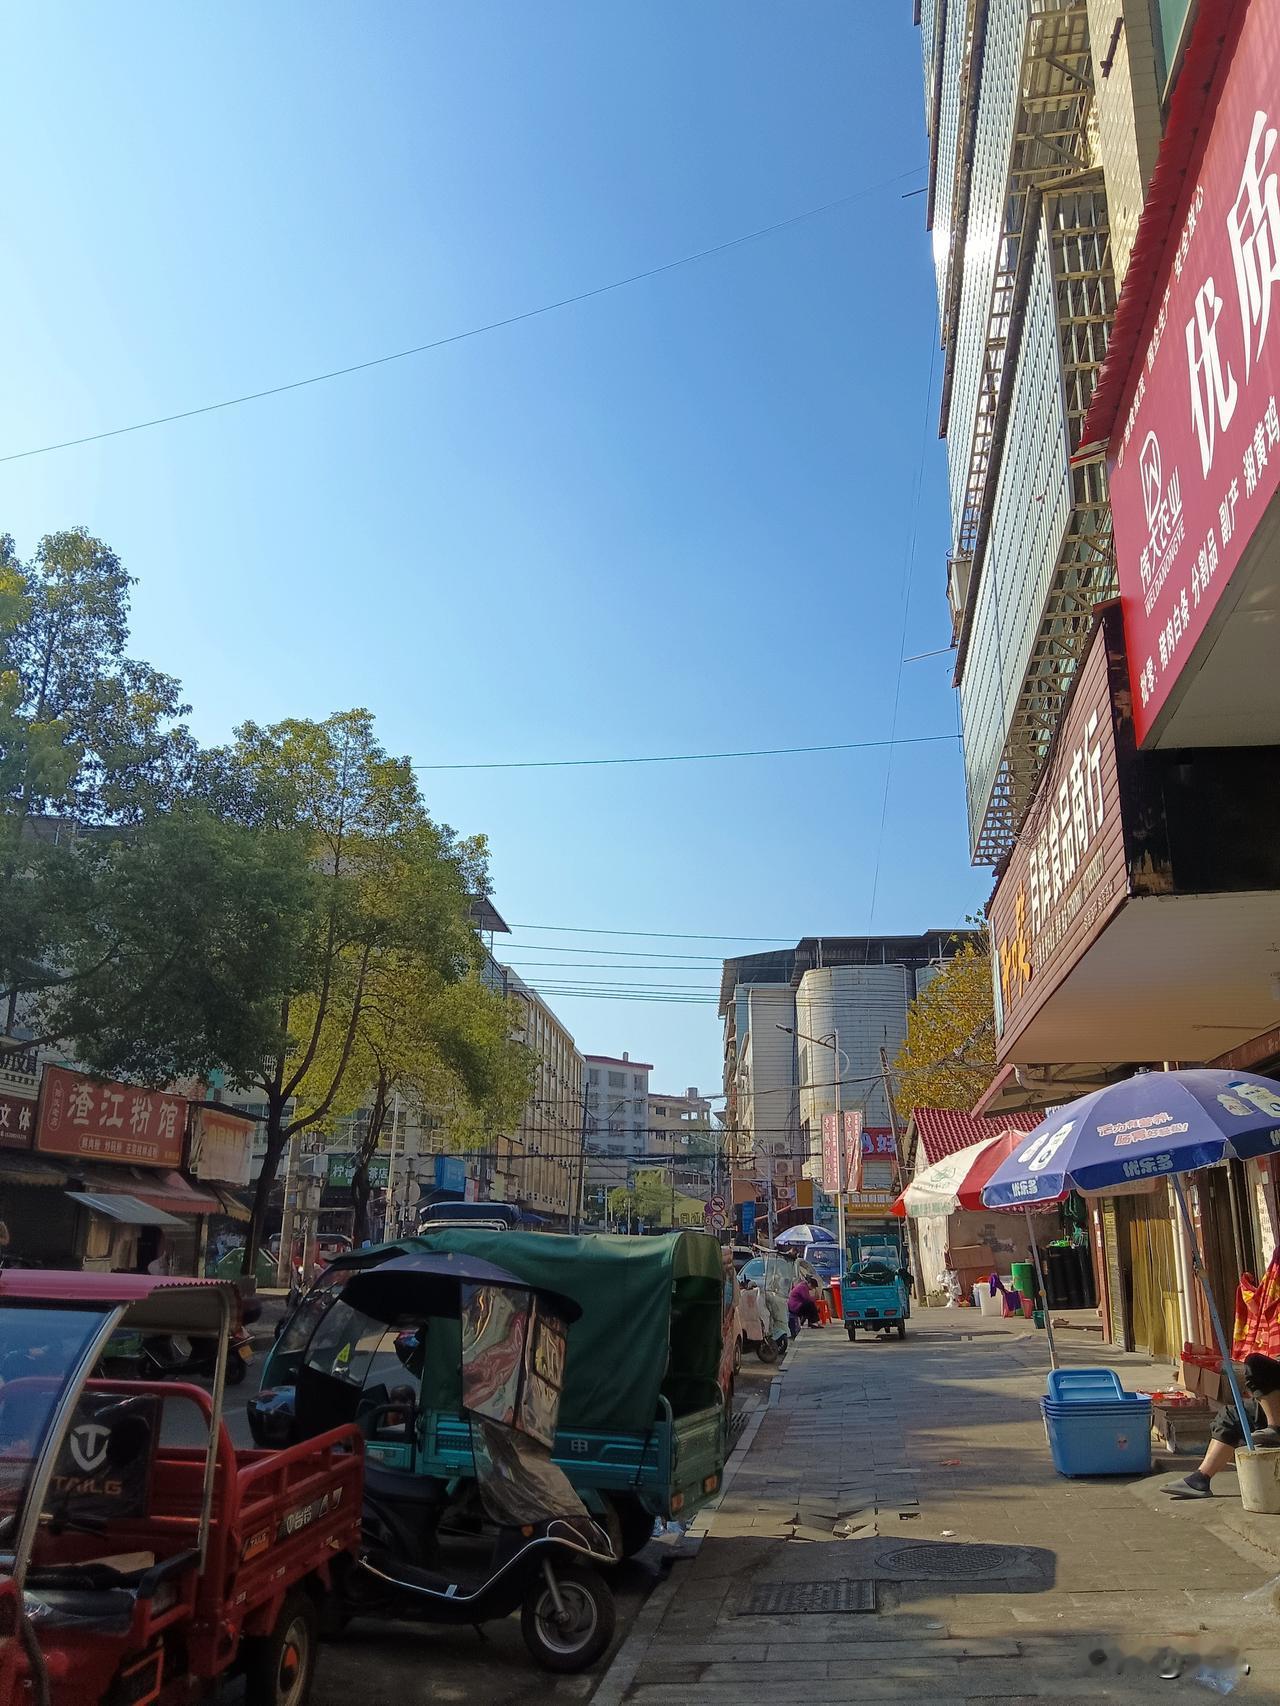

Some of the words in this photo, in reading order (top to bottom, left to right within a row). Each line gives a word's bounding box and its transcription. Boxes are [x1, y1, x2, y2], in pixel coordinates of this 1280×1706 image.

[1174, 184, 1204, 284] 安全放心
[1185, 110, 1280, 481] 优质
[1140, 465, 1183, 595] 伟大农业
[1158, 587, 1190, 673] 猪肉白条
[1191, 527, 1219, 609] 分割品
[1218, 477, 1239, 550] 副产
[1242, 395, 1280, 500] 湘黄鸡
[67, 1083, 178, 1139] 渣江粉馆
[1123, 1154, 1174, 1178] 优乐多
[51, 1474, 122, 1497] TAILG
